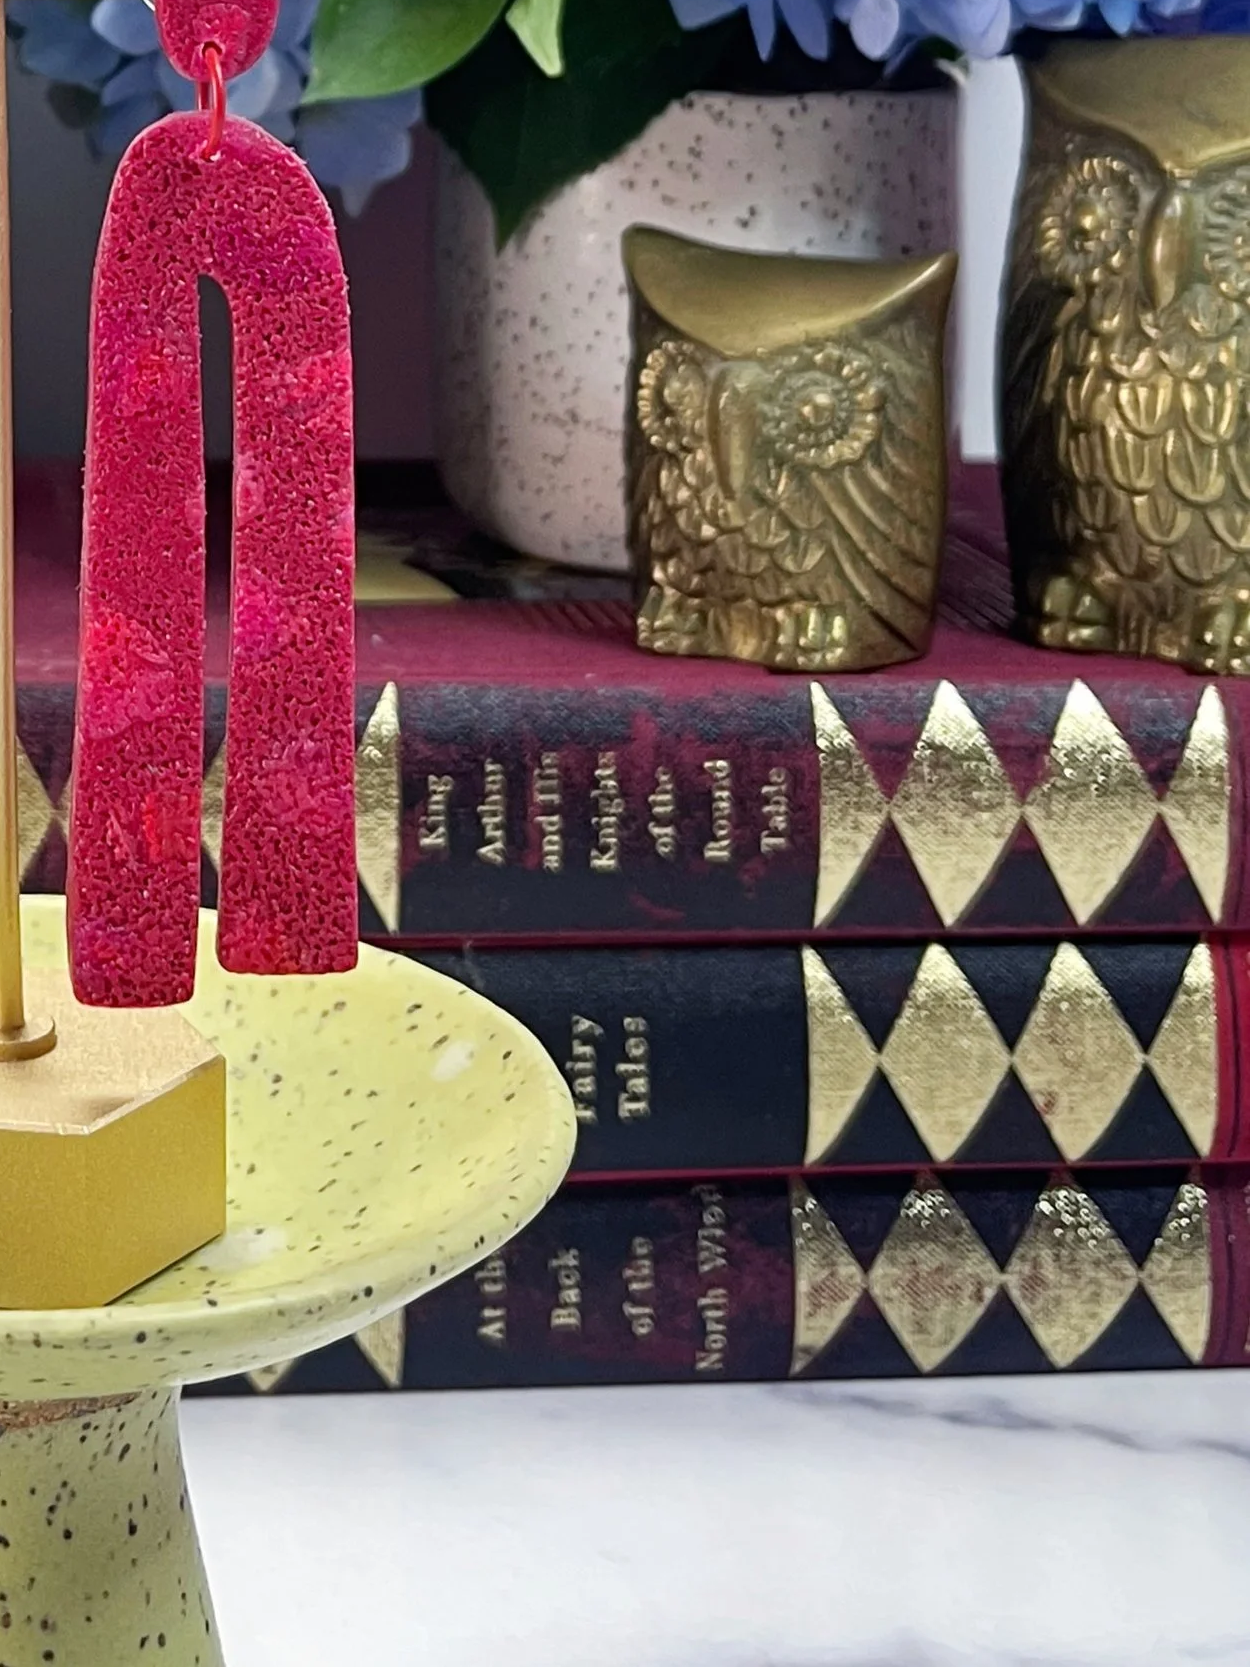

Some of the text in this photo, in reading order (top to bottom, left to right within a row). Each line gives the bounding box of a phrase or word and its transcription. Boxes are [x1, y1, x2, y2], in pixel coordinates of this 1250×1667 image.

[418, 773, 455, 851] King
[476, 757, 508, 867] Arthur
[533, 813, 564, 874] and
[589, 751, 625, 874] Knights
[648, 765, 677, 860] of the
[703, 759, 733, 864] Round
[760, 766, 789, 855] Table
[615, 1016, 650, 1124] Tales
[475, 1248, 508, 1344] At th
[548, 1246, 582, 1332] Back
[622, 1236, 655, 1338] of the
[695, 1287, 729, 1372] North
